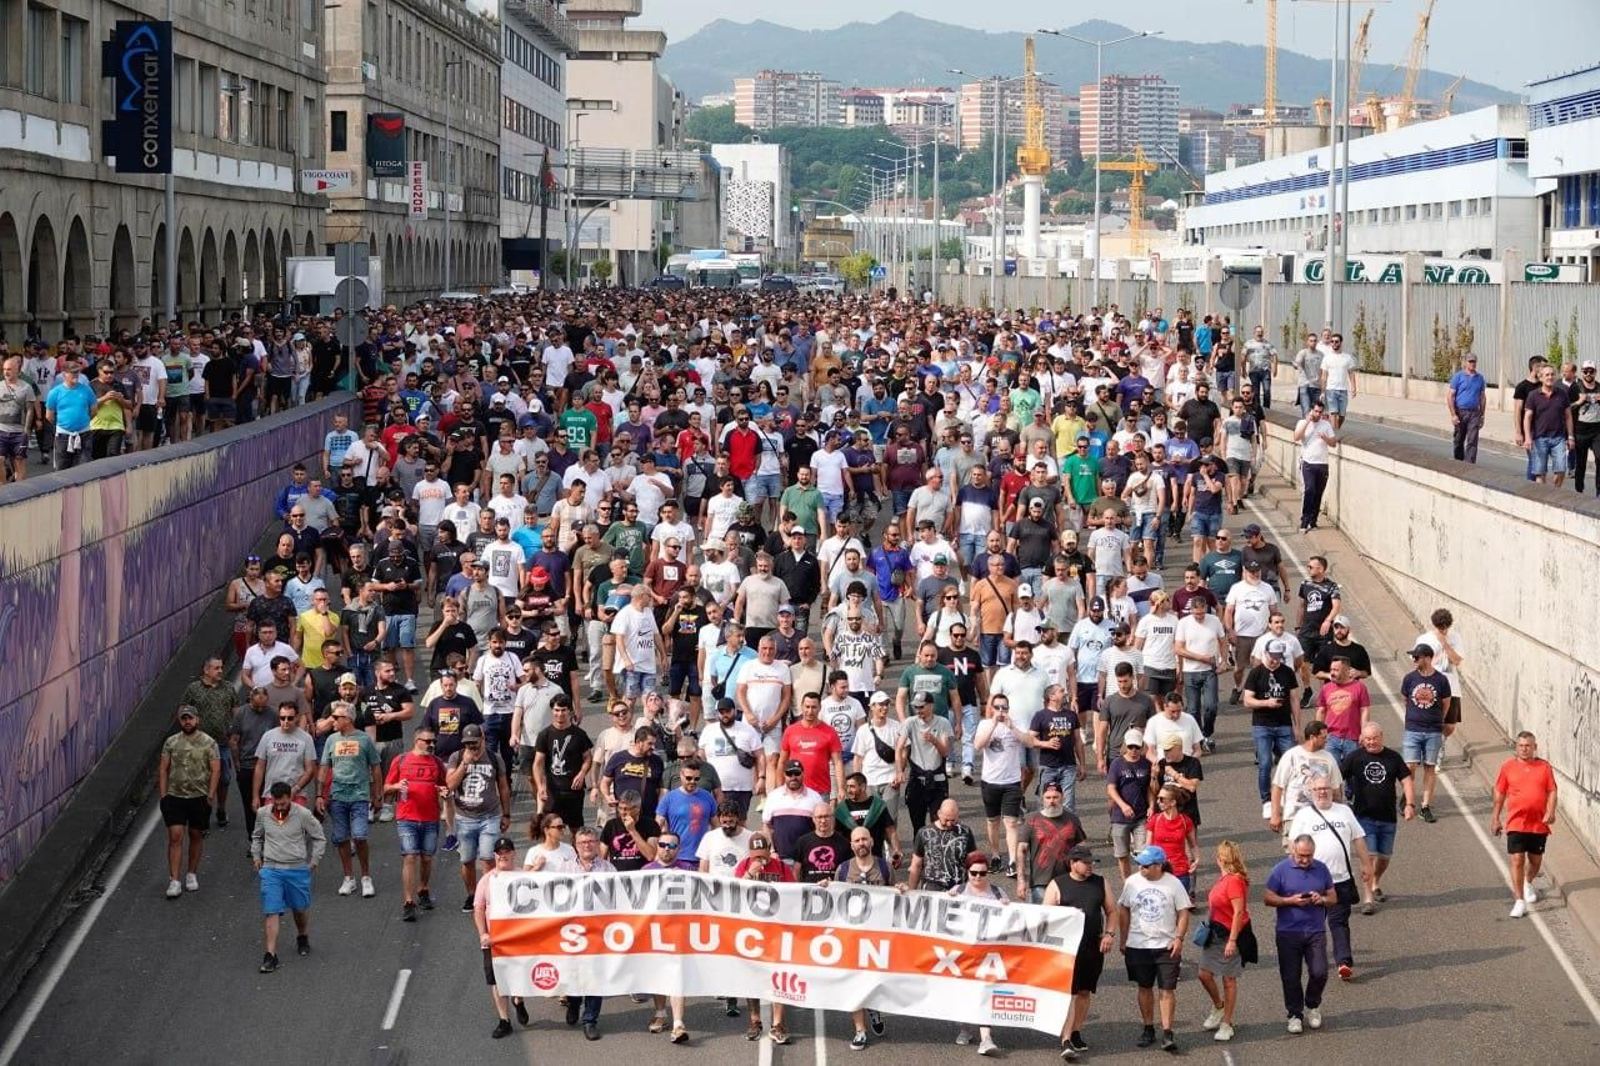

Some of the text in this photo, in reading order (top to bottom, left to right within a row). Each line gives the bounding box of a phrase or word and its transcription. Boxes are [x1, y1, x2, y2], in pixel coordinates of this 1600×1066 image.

[143, 54, 159, 169] conxemar
[567, 426, 586, 443] 93
[953, 657, 969, 676] N
[272, 741, 298, 749] TOMMY
[506, 875, 1065, 947] CONVENIO DO METAL
[559, 921, 1009, 981] SOLUCIÓN XA
[993, 995, 1035, 1012] CCOO
[991, 1011, 1035, 1023] industria
